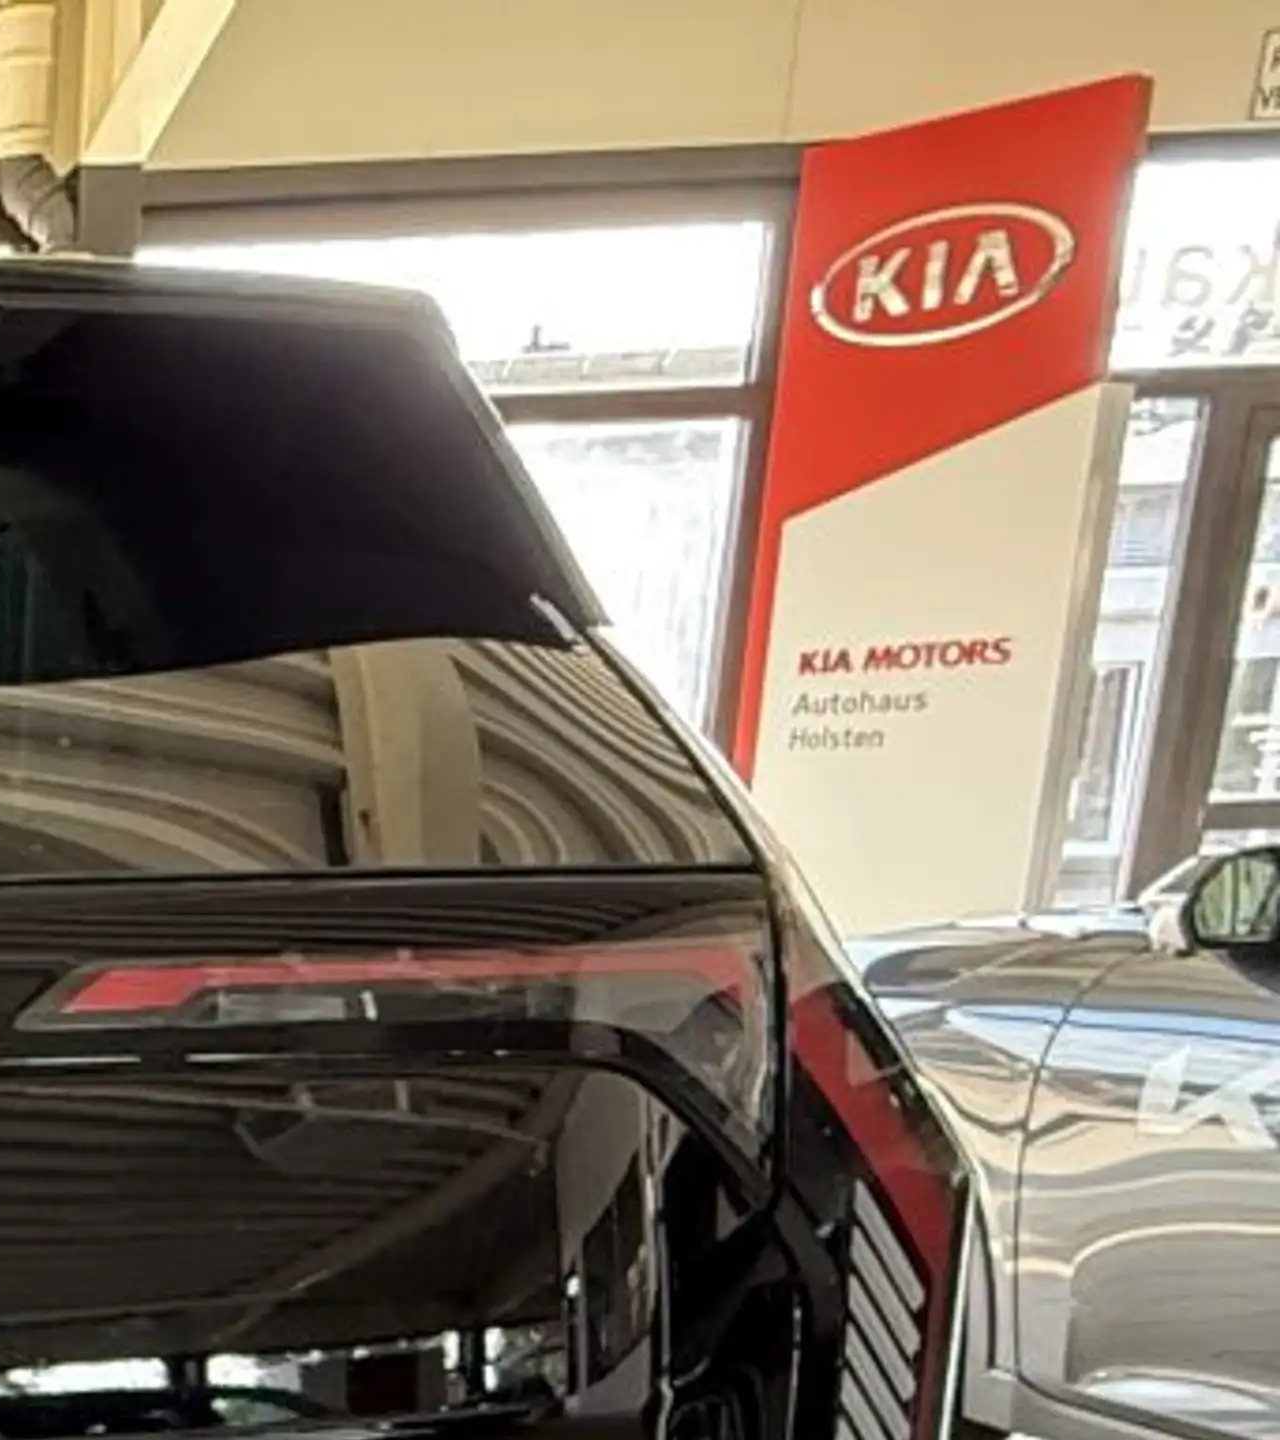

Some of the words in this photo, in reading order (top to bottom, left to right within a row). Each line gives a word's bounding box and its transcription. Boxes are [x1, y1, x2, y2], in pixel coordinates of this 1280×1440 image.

[853, 229, 1020, 323] KIA
[798, 648, 853, 675] KIA
[863, 637, 1013, 671] MOTORS
[792, 690, 928, 716] Autohaus
[788, 726, 885, 751] Holsten
